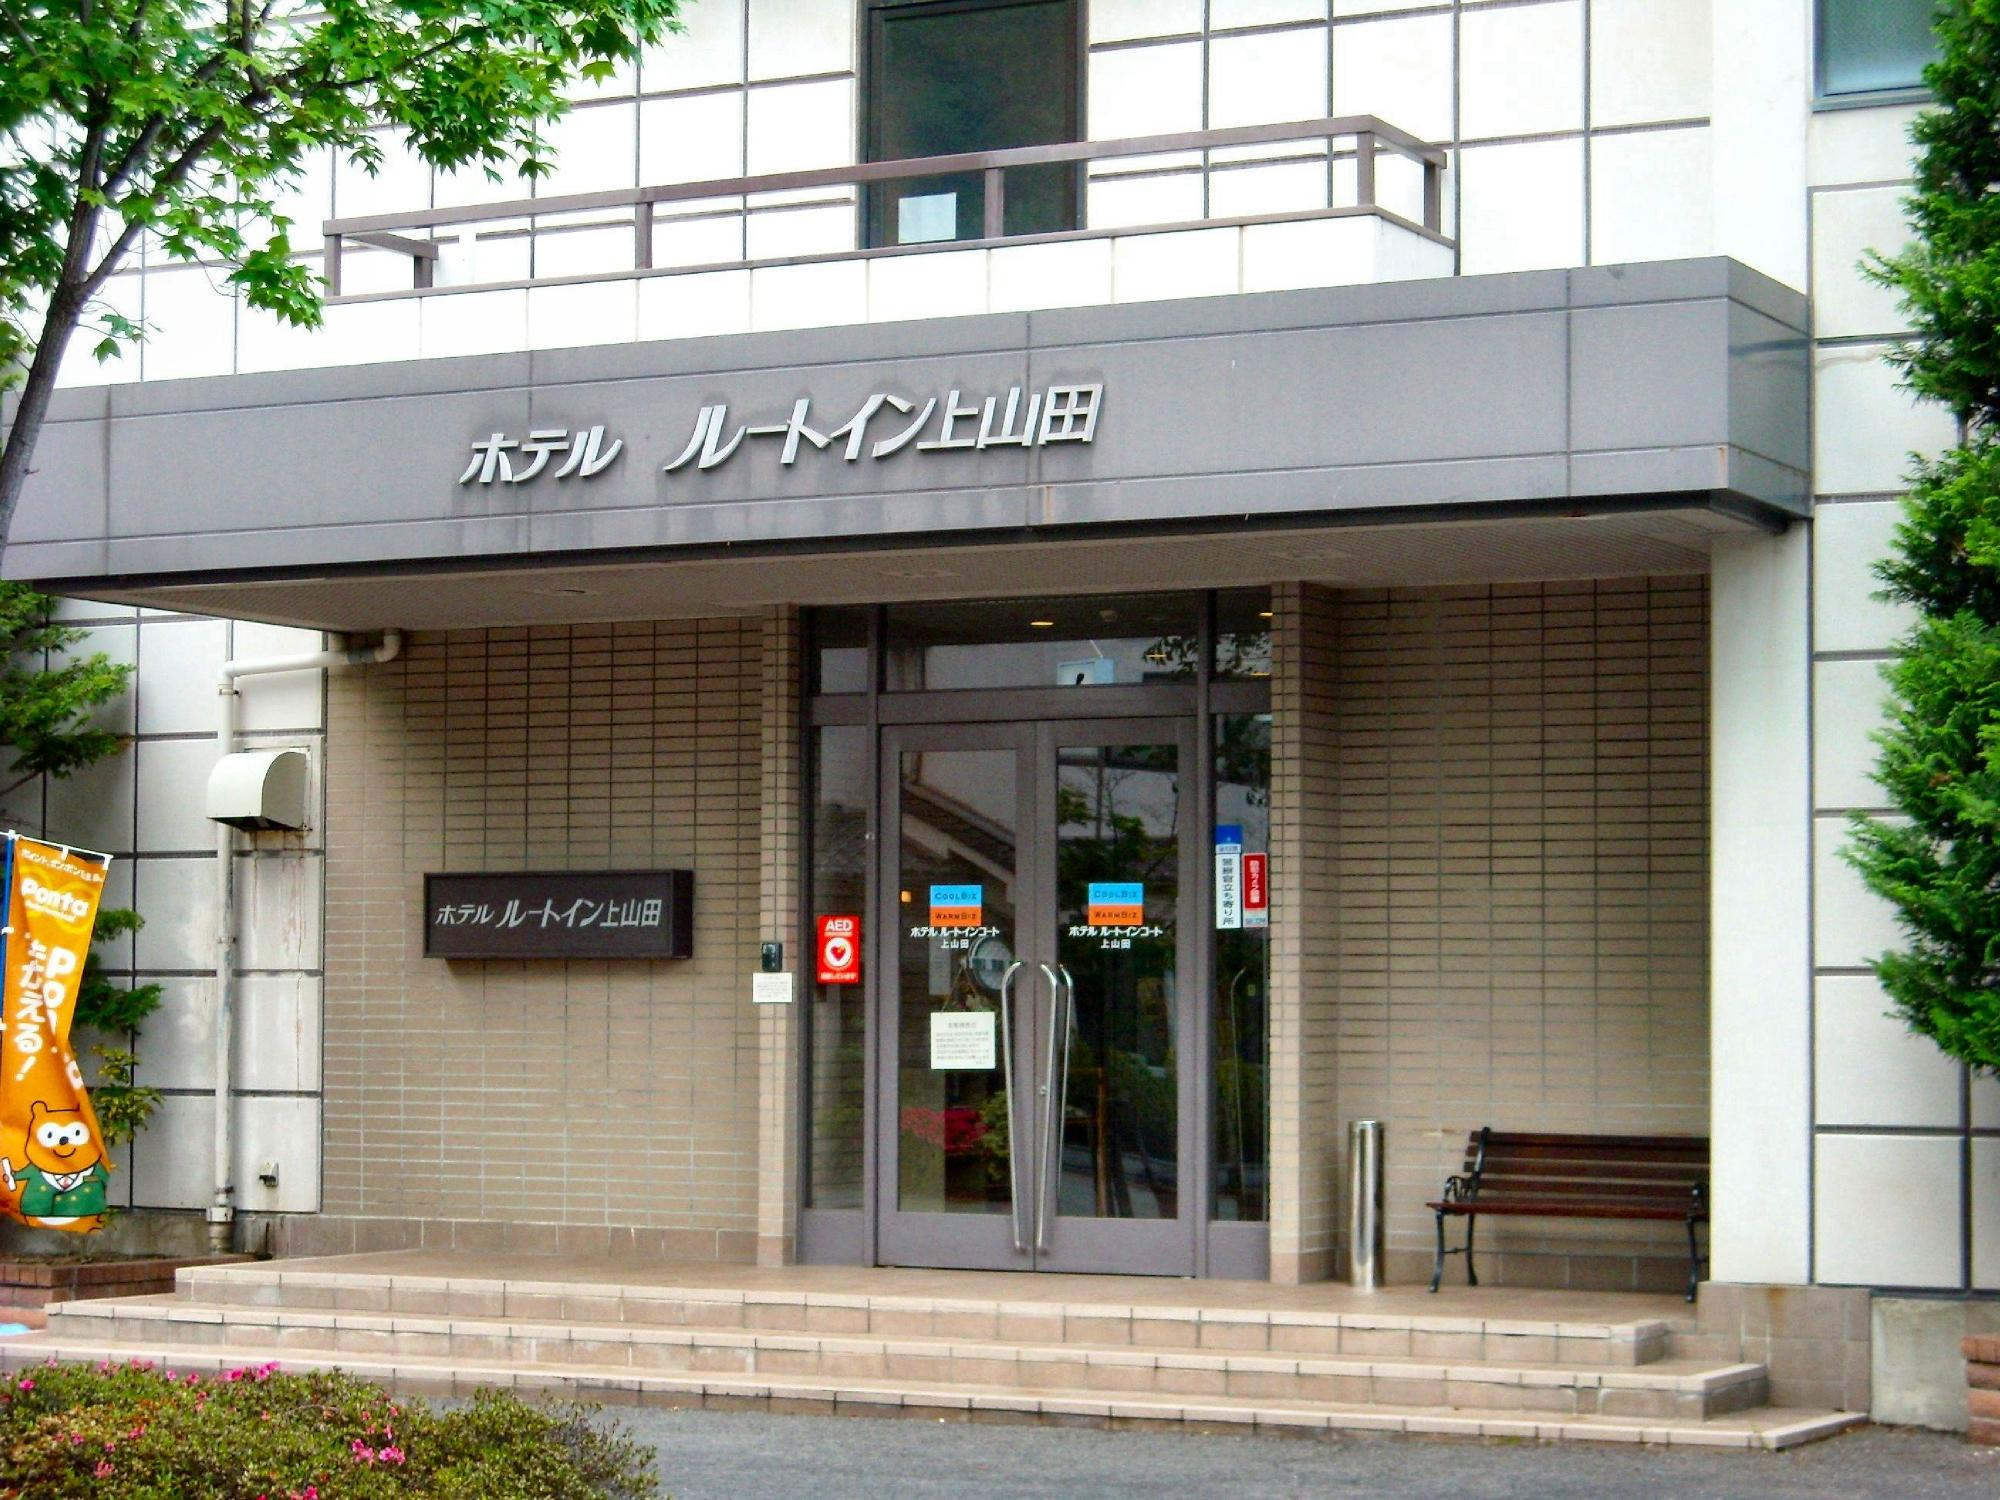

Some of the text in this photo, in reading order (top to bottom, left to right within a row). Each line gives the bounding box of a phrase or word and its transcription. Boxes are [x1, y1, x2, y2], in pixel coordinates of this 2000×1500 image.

[459, 383, 1103, 484] ホテル ルートイン上山田
[22, 877, 89, 916] Ponta
[435, 899, 662, 928] ホテル ルートイン上山田
[825, 919, 853, 932] AED
[1068, 925, 1163, 937] ホテル ルートインコート
[910, 926, 1000, 938] ホテル ルートインコート
[940, 938, 969, 950] 上山田
[1100, 938, 1131, 949] 上山田
